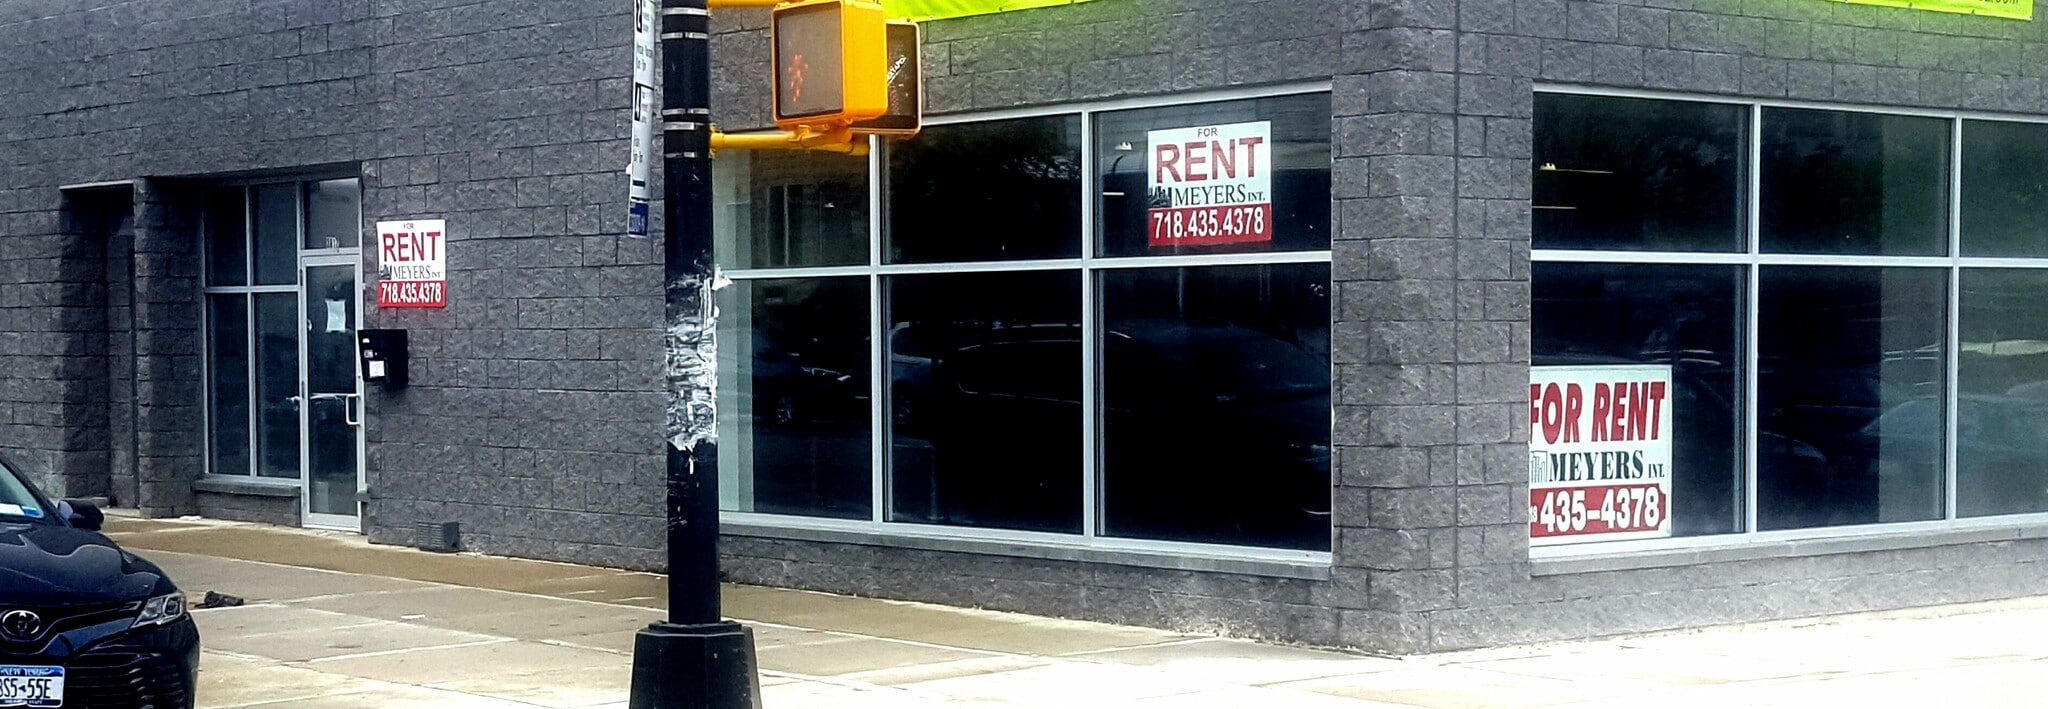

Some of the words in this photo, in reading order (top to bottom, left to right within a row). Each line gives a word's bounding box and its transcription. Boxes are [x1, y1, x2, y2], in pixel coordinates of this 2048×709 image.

[1197, 127, 1218, 138] FOR
[1156, 136, 1263, 184] RENT
[1174, 183, 1246, 207] MEYERS
[1153, 206, 1265, 239] 718.435.4378
[383, 231, 441, 262] RENT
[393, 265, 431, 279] MEYERS
[381, 282, 441, 303] 718.435.4378
[1530, 382, 1583, 445] FOR
[1591, 381, 1666, 443] RENT
[1549, 450, 1644, 482] MEYERS
[1540, 486, 1660, 533] 435-4378
